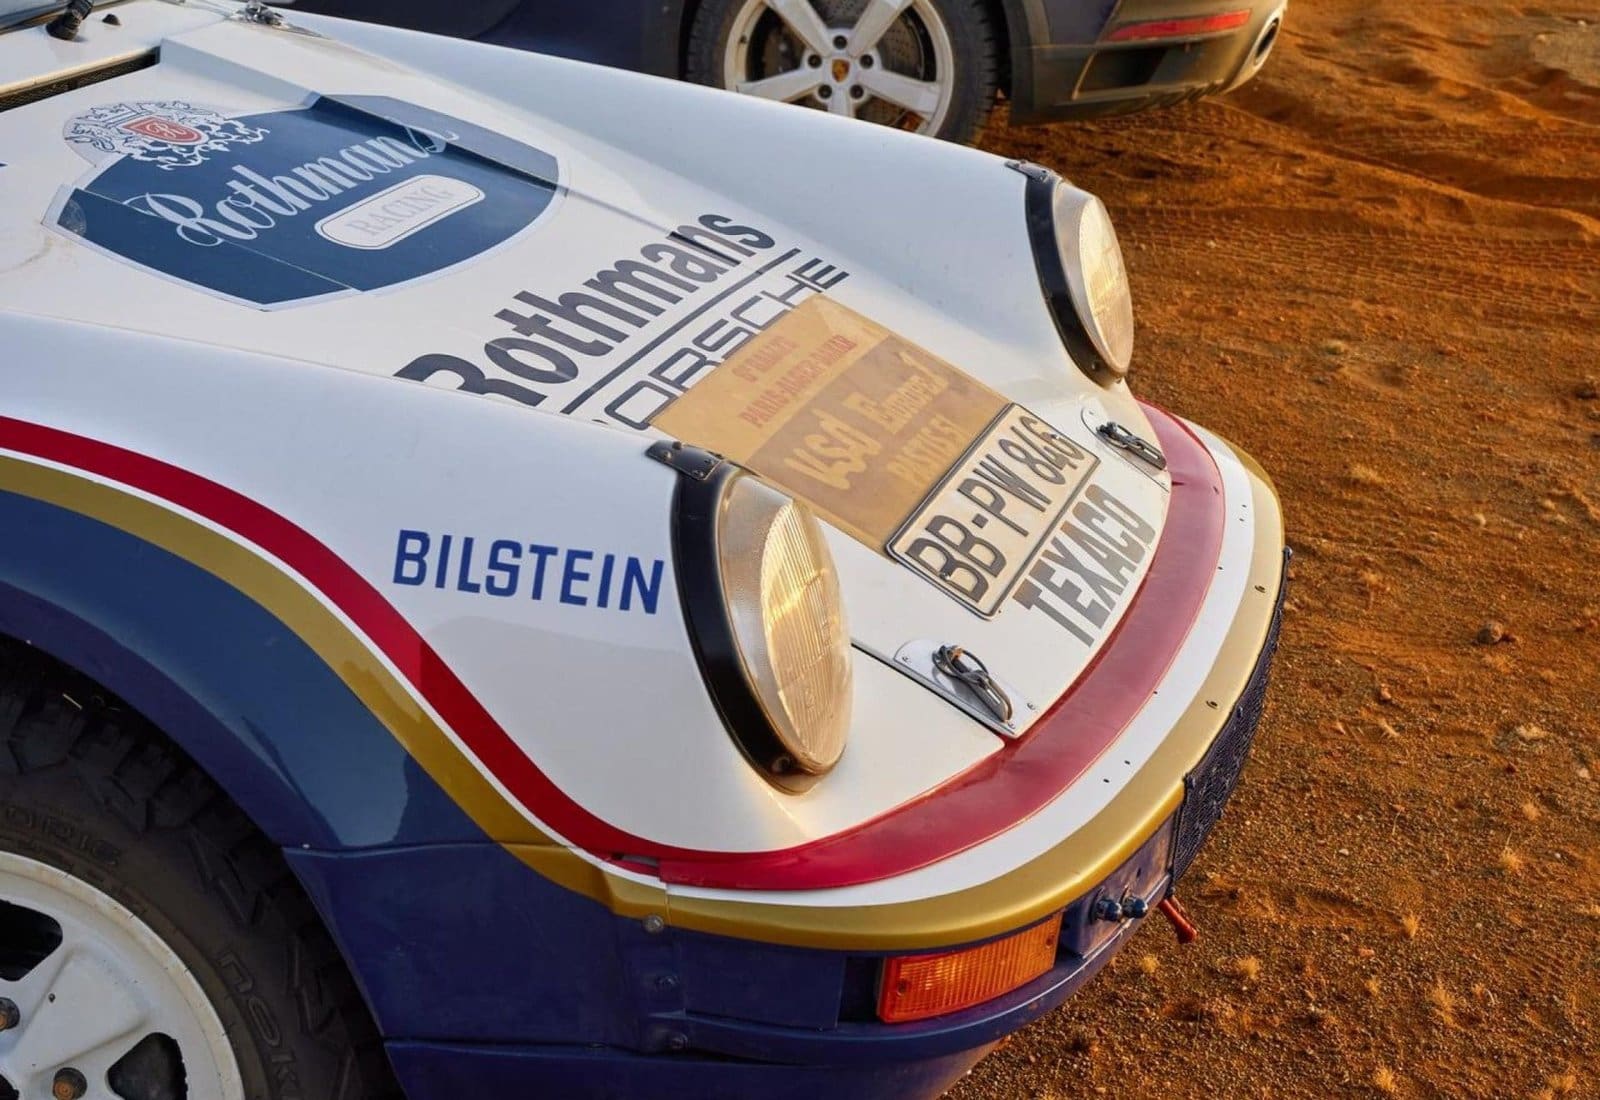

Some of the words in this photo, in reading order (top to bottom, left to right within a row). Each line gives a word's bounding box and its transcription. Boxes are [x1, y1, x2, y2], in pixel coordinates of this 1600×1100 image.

[123, 126, 459, 247] Rothmans
[346, 183, 454, 236] RACING
[393, 214, 776, 407] Rothmans
[596, 258, 849, 431] ORSCHE
[393, 529, 665, 614] BILSTEIN
[904, 453, 1053, 604] BB-PW
[998, 415, 1085, 485] 846
[1012, 483, 1156, 648] TEXACO
